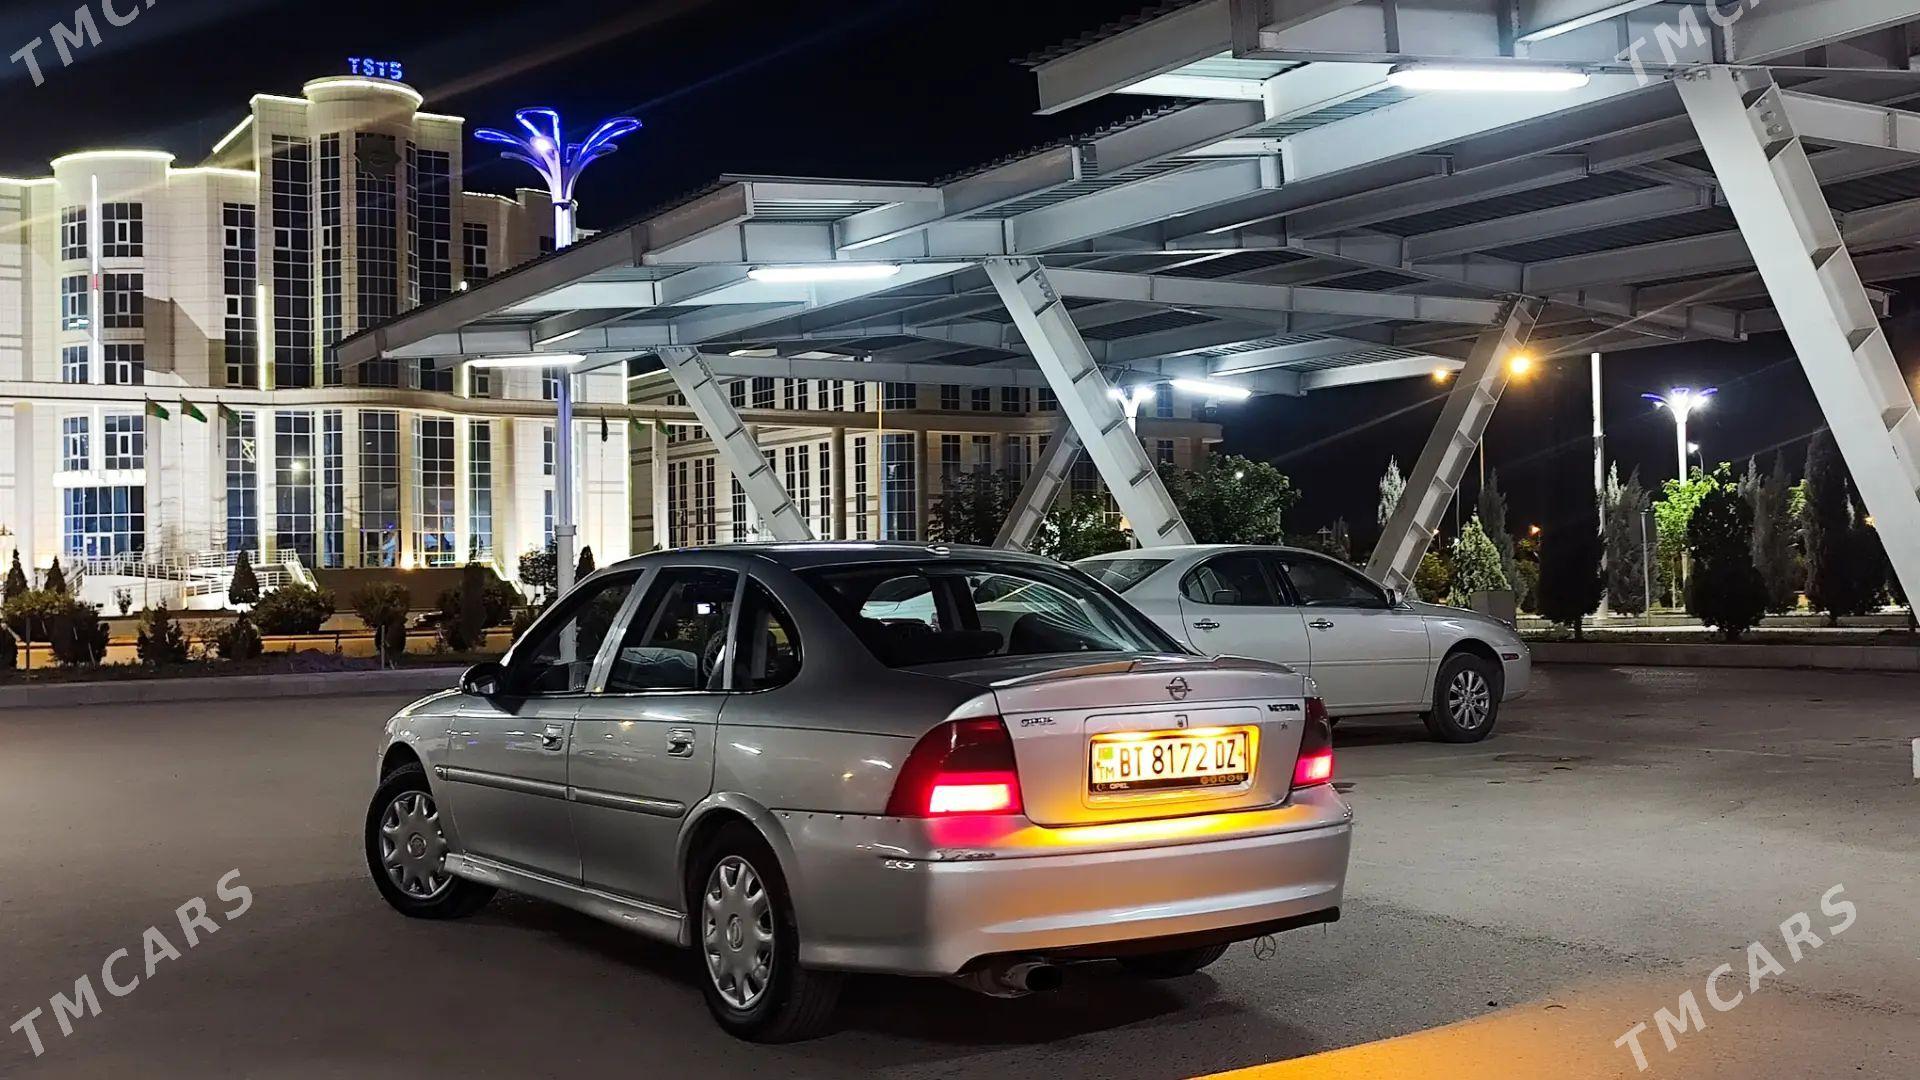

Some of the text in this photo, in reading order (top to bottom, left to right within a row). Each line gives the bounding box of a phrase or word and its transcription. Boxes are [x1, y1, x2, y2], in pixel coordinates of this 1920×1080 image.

[1120, 739, 1236, 777] BT 8172 DZ
[1098, 766, 1115, 780] TM
